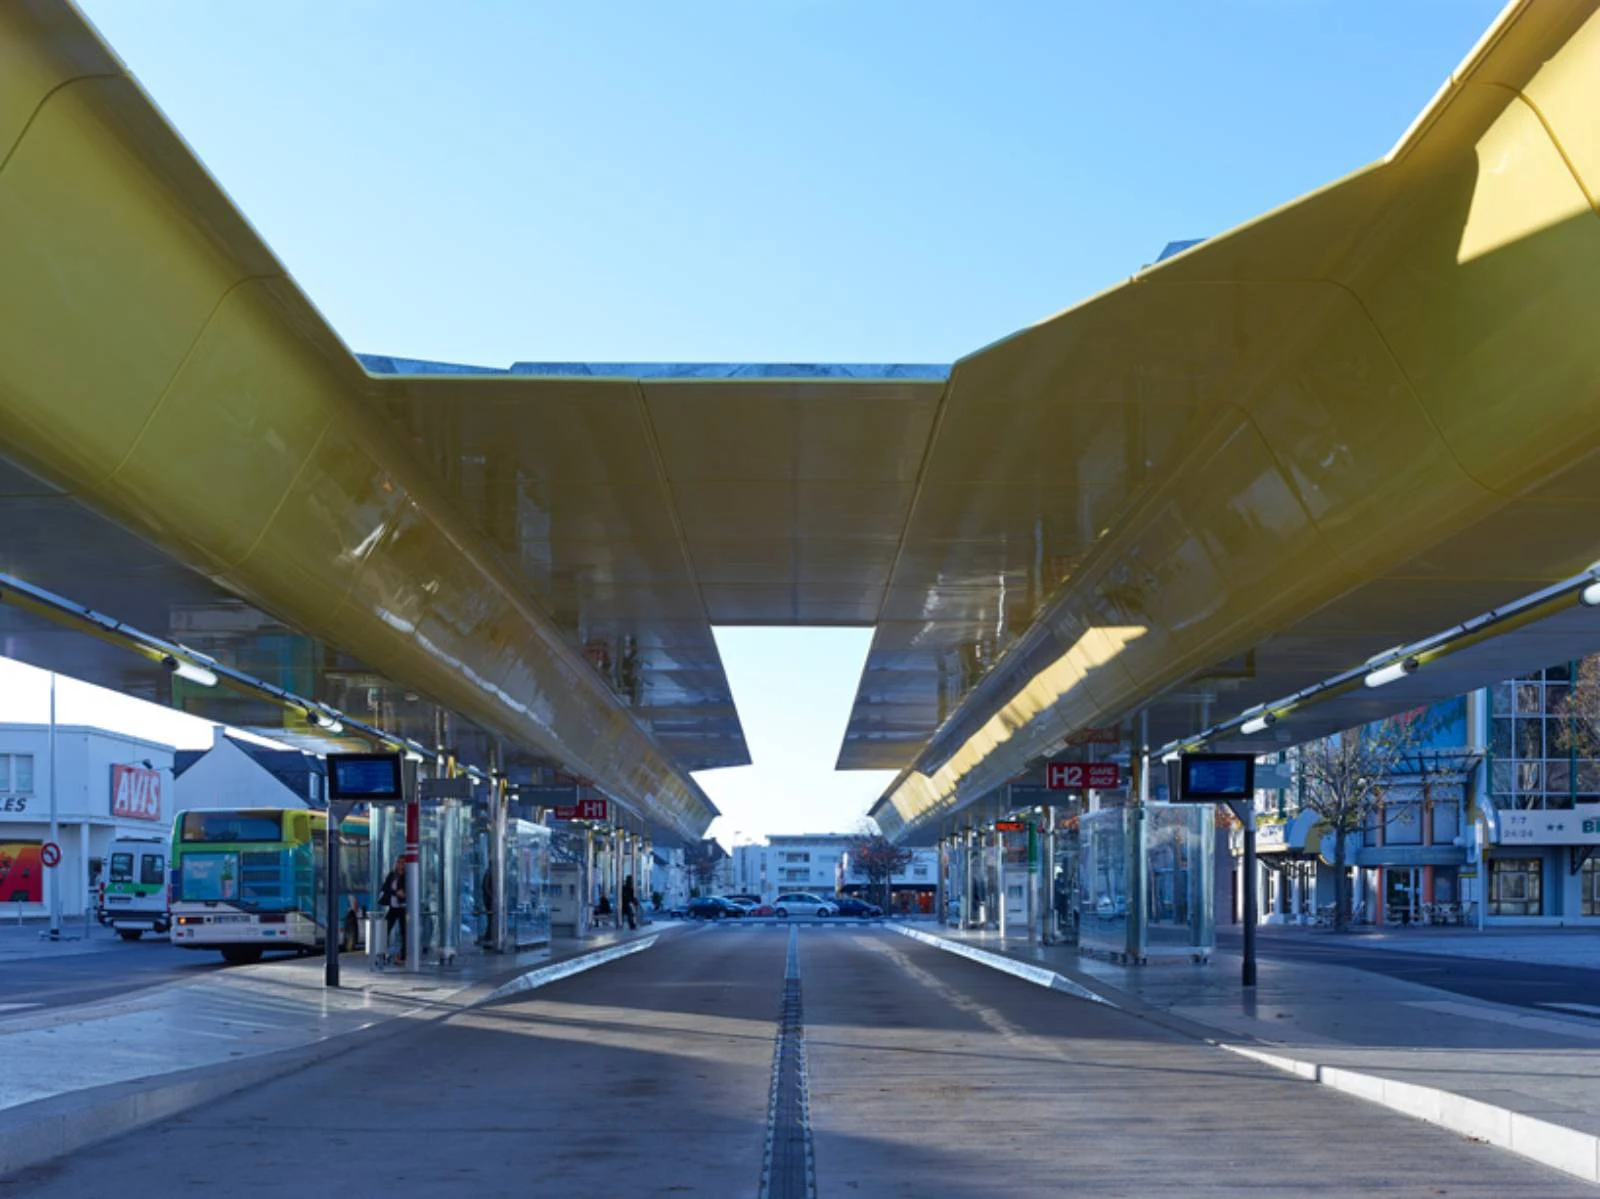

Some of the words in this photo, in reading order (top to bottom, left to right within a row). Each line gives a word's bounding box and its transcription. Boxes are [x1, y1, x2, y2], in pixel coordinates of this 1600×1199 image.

[1052, 766, 1082, 786] H2
[115, 771, 158, 815] AVIS
[584, 801, 603, 817] H1
